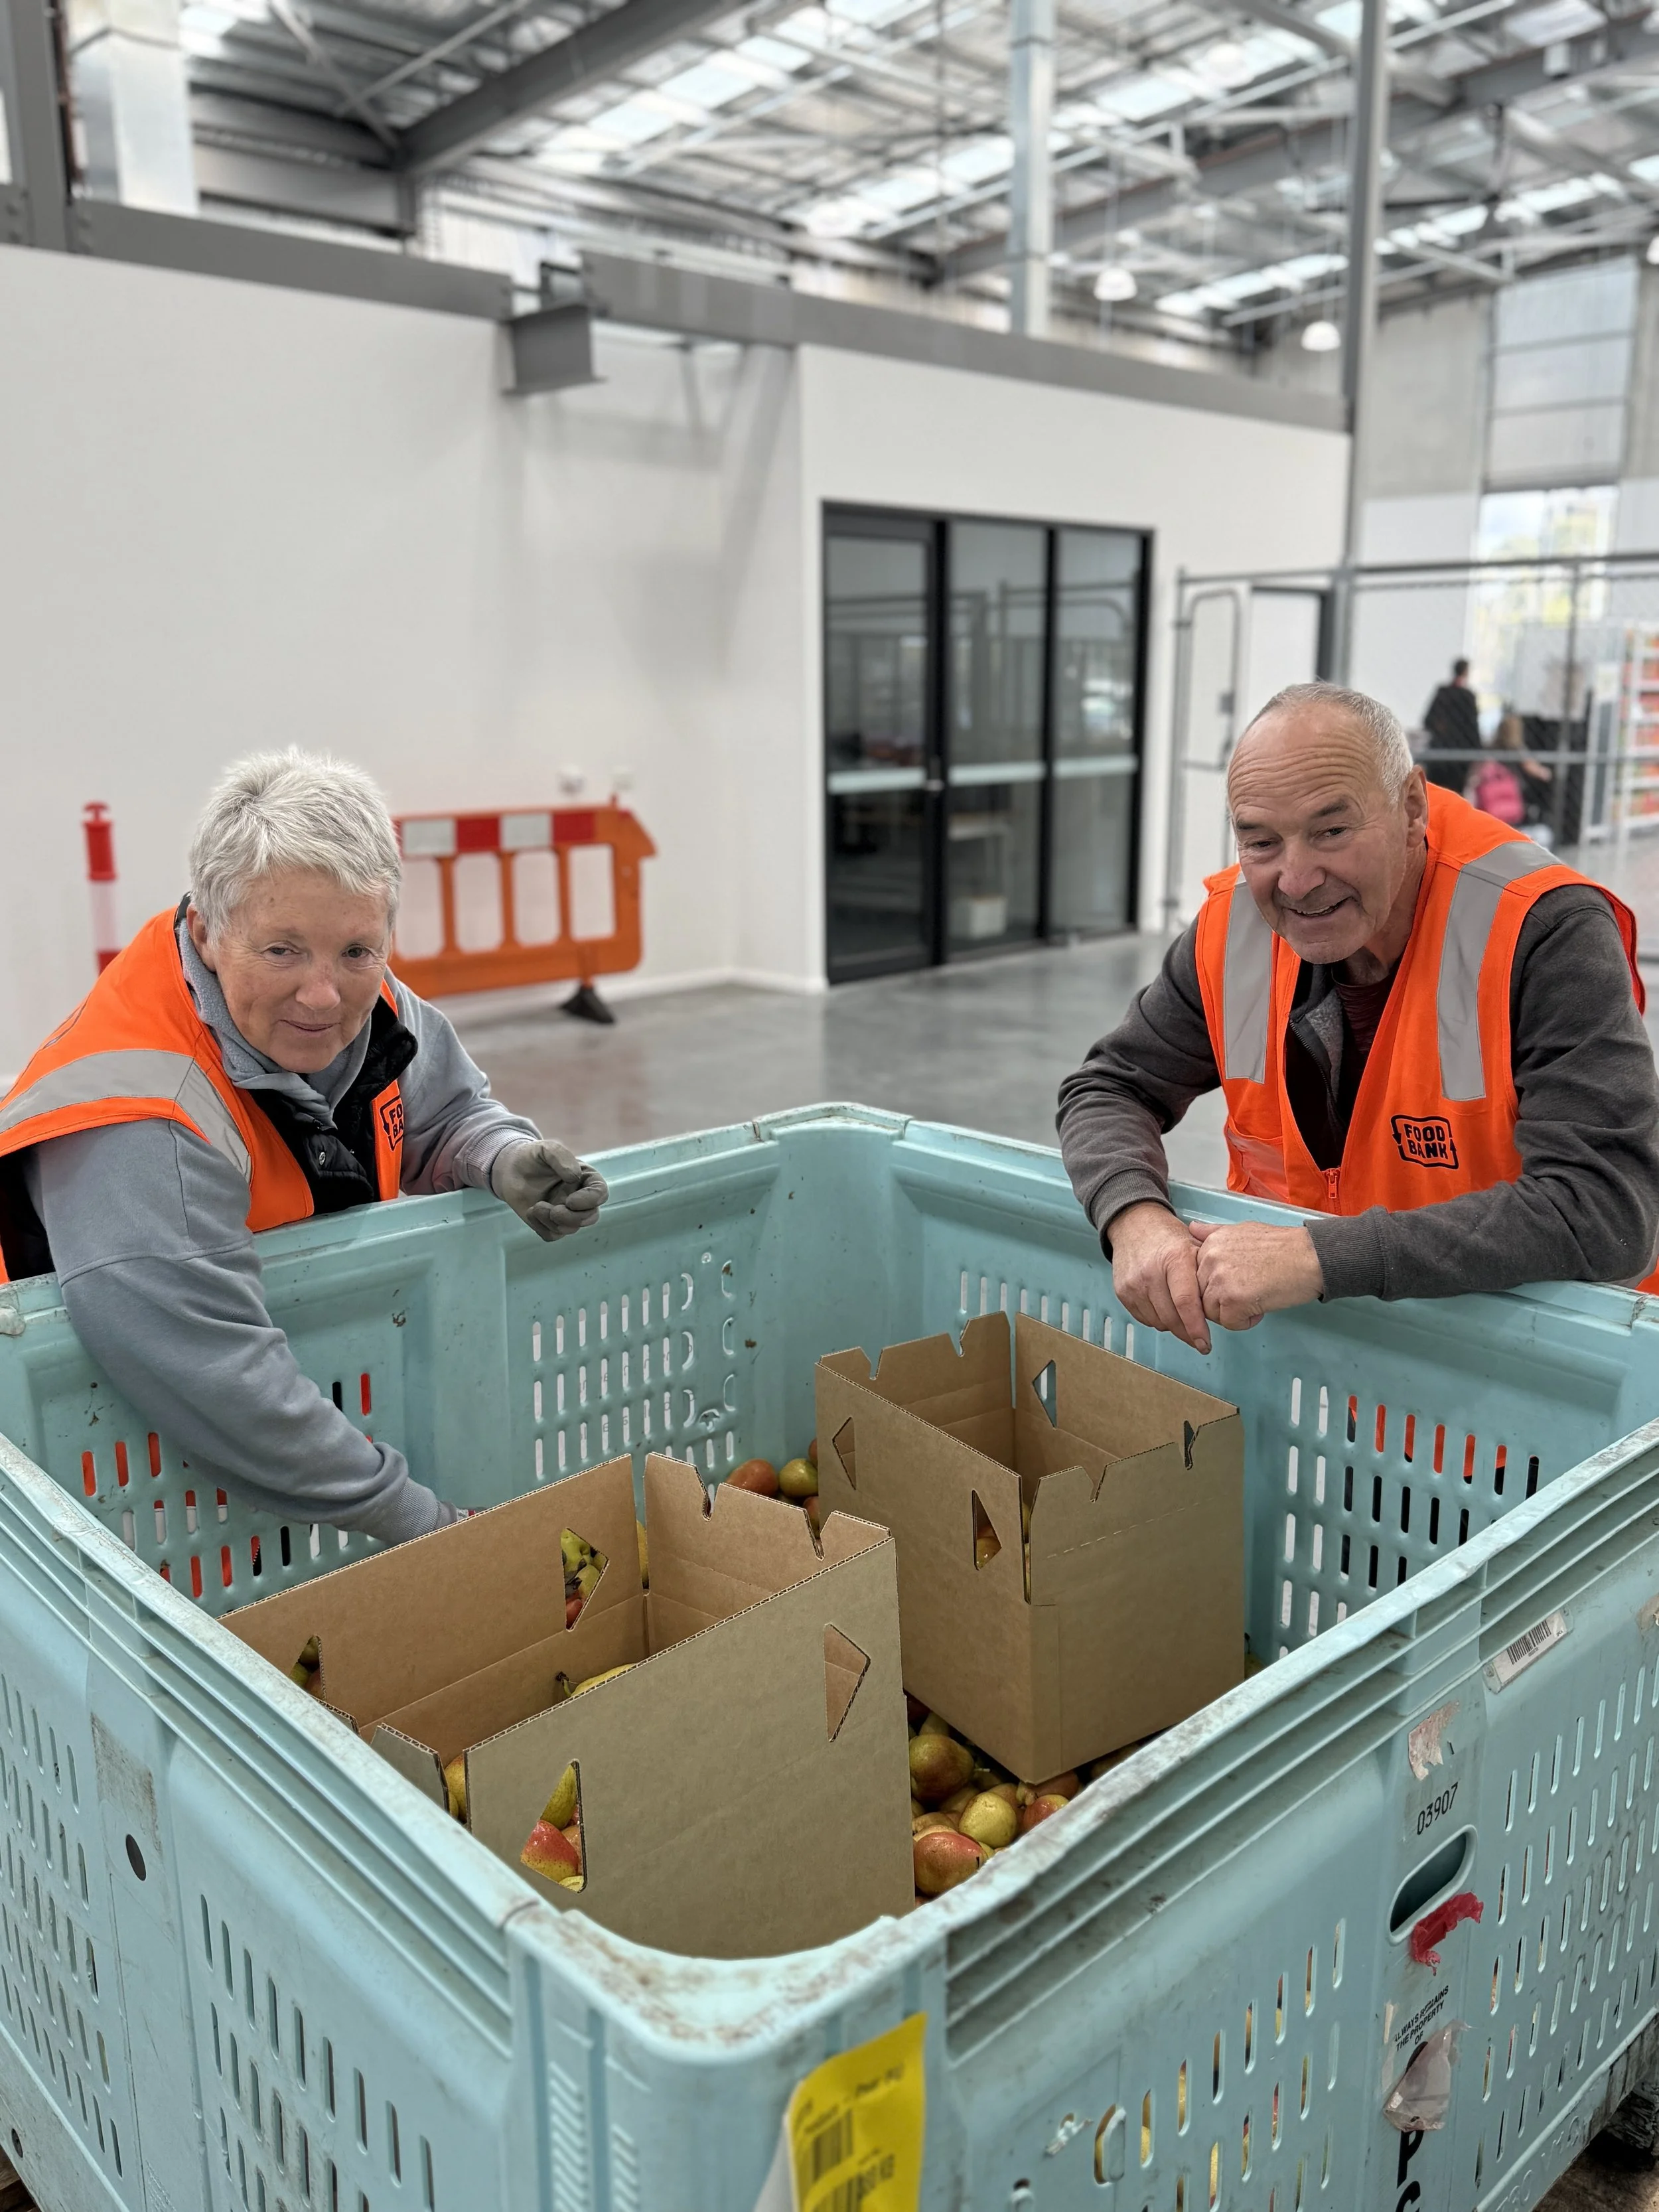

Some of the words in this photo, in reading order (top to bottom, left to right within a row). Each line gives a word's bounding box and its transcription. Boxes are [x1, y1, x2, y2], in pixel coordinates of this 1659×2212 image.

[389, 1103, 403, 1124] FO
[393, 1118, 403, 1139] BA
[1404, 1123, 1446, 1142] FOOD
[1407, 1139, 1449, 1159] BANK
[1417, 1781, 1459, 1835] 03907
[1396, 2033, 1409, 2052] THE
[1409, 2000, 1444, 2039] PROPERTY
[1414, 2030, 1423, 2045] OF
